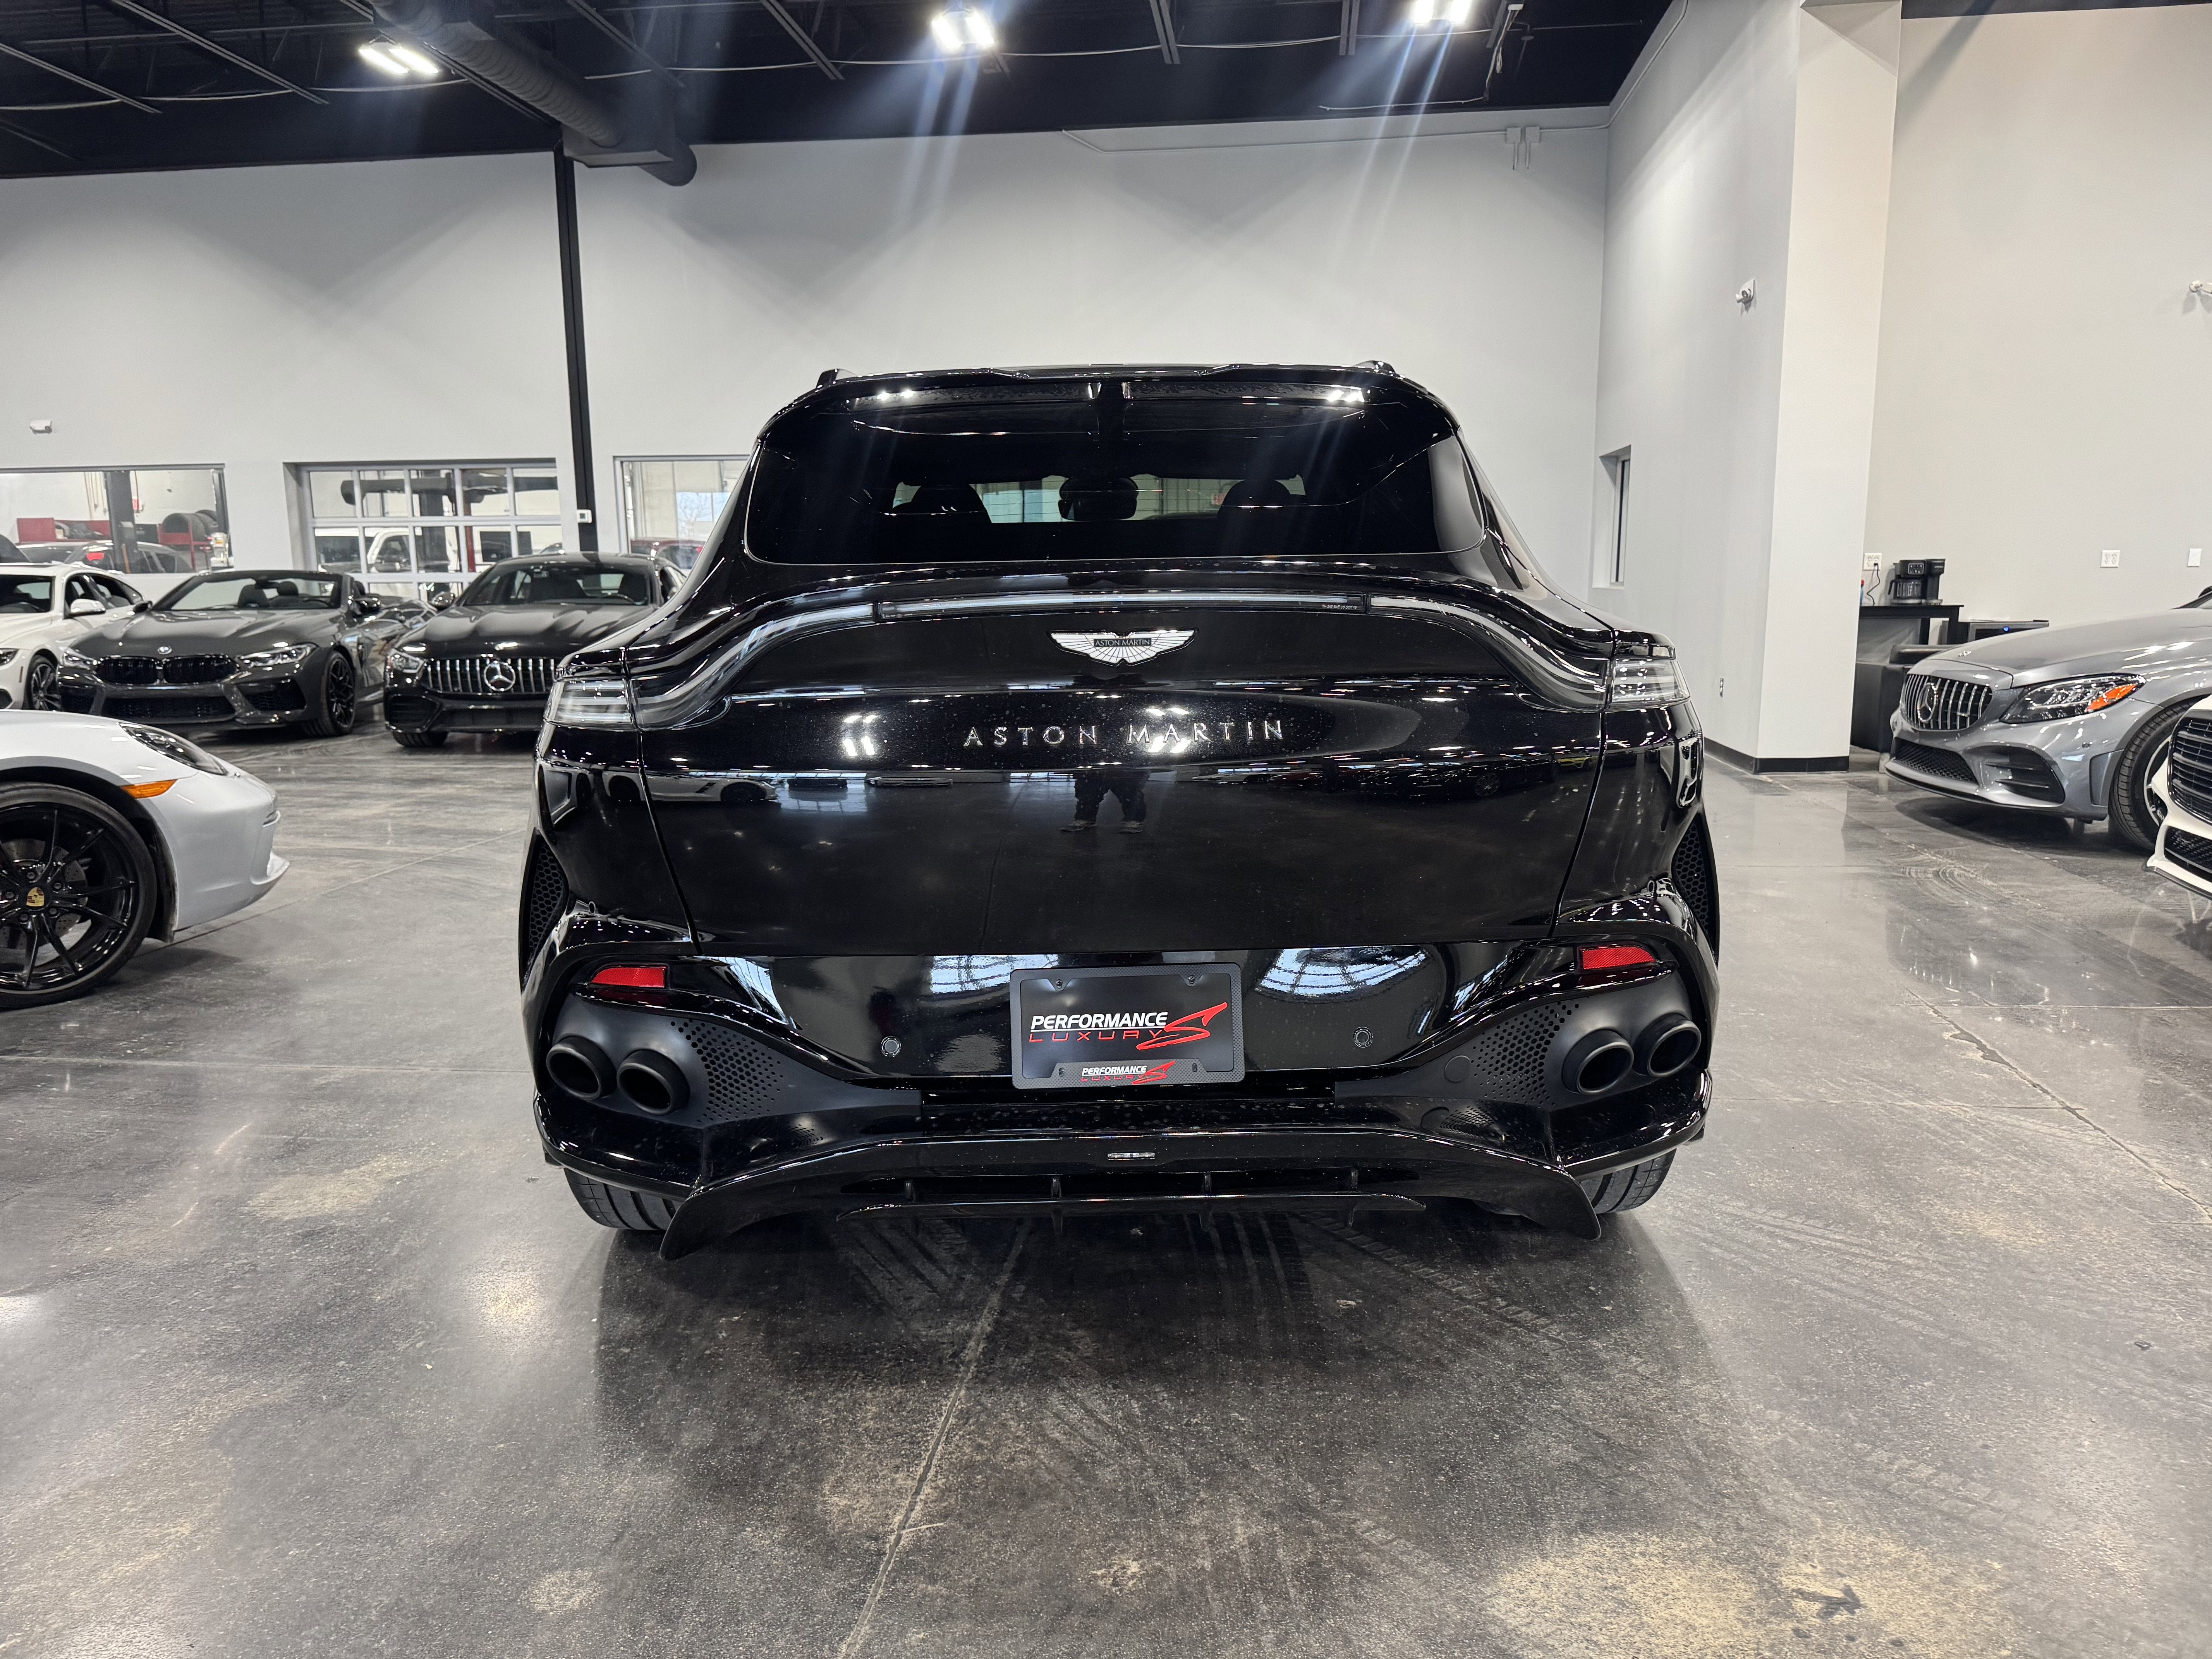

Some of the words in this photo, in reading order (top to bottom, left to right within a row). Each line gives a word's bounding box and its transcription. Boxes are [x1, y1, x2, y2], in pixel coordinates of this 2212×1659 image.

[963, 725, 1098, 747] ASTON
[1127, 720, 1283, 744] MARTIN
[1030, 1012, 1168, 1030] PERFORMANCE
[1029, 1029, 1163, 1043] LUXURY
[1082, 1065, 1147, 1075] PERFORMANCE
